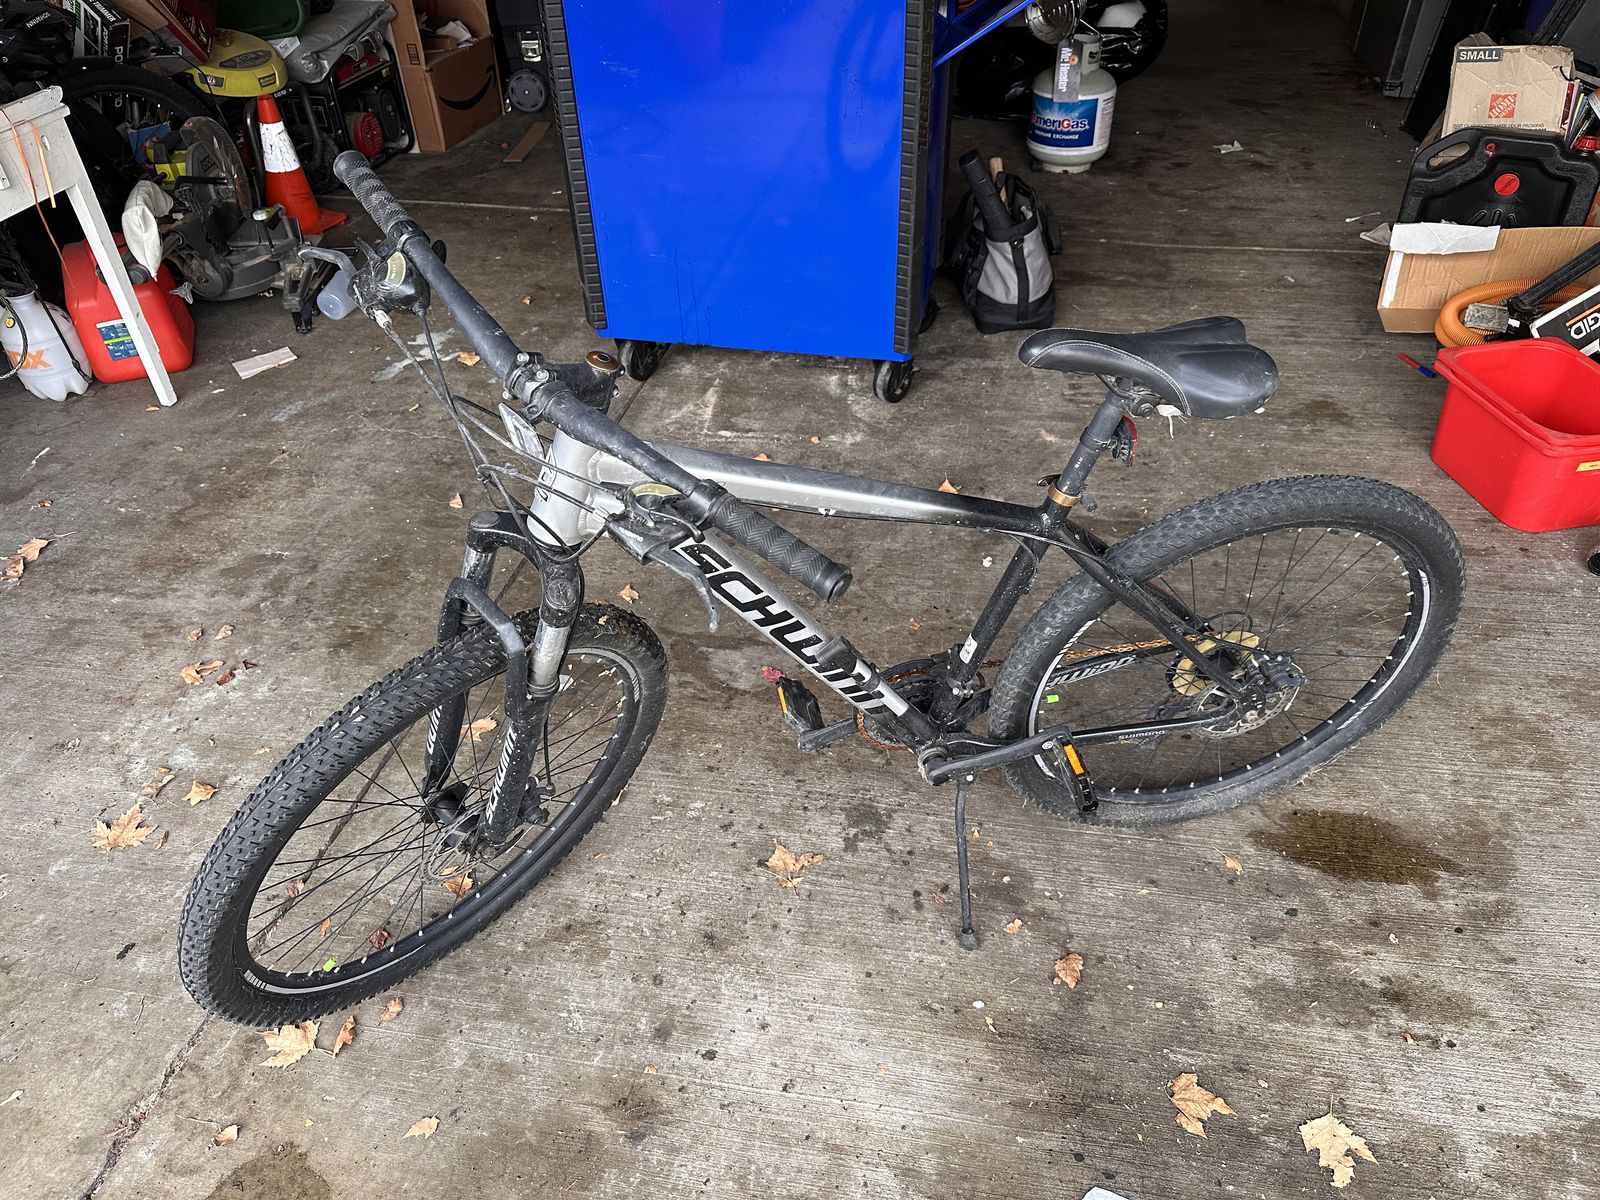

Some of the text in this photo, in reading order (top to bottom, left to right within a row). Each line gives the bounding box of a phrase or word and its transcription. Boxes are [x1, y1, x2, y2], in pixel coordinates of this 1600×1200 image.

[1459, 50, 1499, 61] SMALL
[1058, 63, 1070, 93] Heater
[1489, 94, 1518, 118] HOME
[1031, 112, 1088, 130] AmeriGas
[7, 349, 50, 369] DX
[485, 723, 517, 825] SCHWINN
